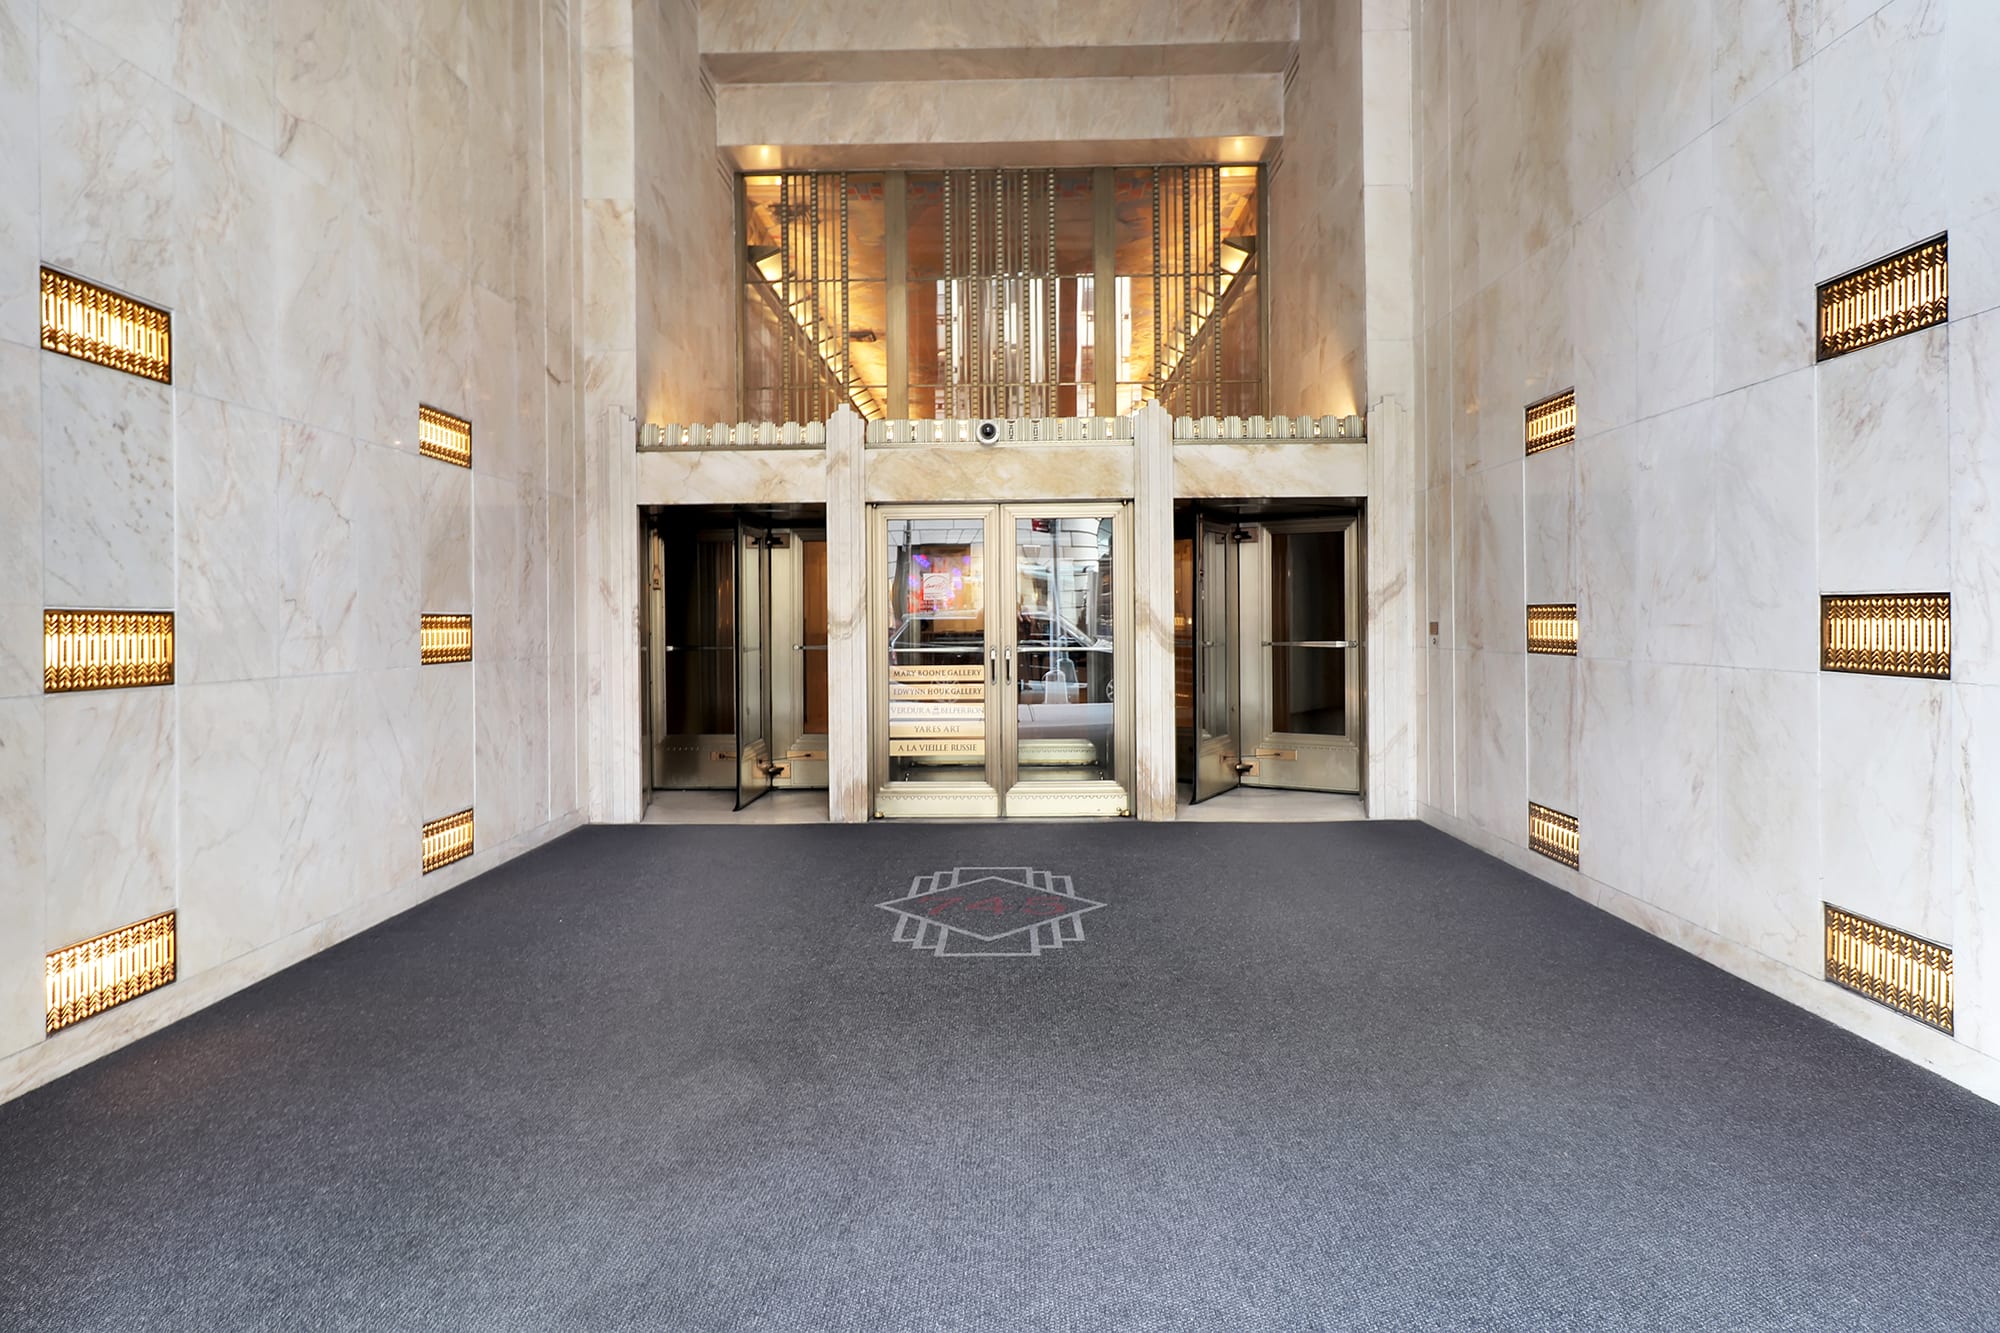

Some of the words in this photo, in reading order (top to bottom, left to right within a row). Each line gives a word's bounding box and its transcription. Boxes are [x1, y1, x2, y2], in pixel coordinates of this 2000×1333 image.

[927, 687, 950, 695] HOUK
[951, 687, 982, 695] GALLERY
[914, 725, 941, 733] YARES
[943, 725, 961, 733] ART
[906, 744, 917, 752] LA
[919, 744, 948, 752] VIEILLE
[950, 743, 977, 752] RUSSIE
[917, 896, 1066, 916] 745
